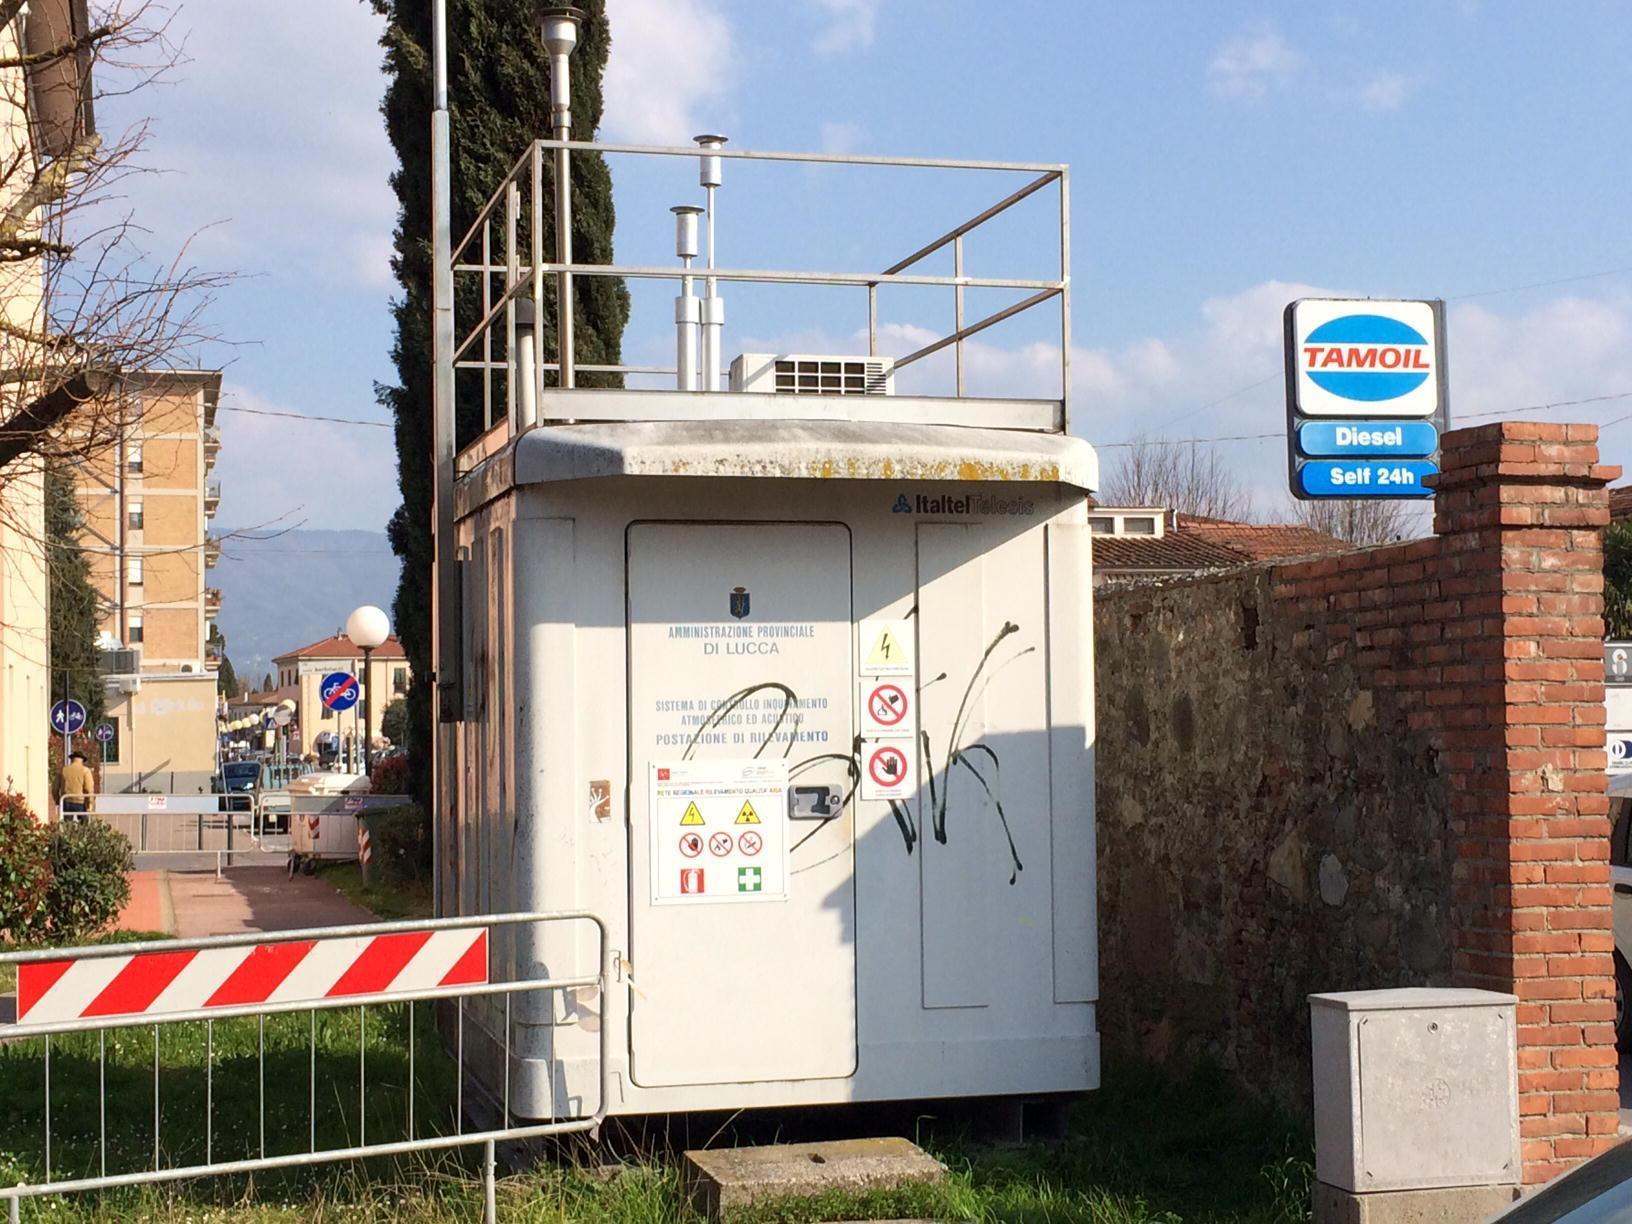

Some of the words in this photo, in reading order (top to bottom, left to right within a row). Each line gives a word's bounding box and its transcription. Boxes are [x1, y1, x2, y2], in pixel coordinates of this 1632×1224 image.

[1304, 347, 1430, 369] TAMOIL
[1335, 427, 1402, 446] Diesel
[1330, 467, 1371, 485] Self
[1377, 467, 1414, 485] 24h
[668, 626, 754, 639] AMMINISTRAZIONE
[757, 625, 815, 638] PROVINCIALE
[704, 643, 719, 655] DI
[726, 642, 780, 655] LUCCA
[655, 700, 694, 712] SISTEMA
[698, 700, 707, 711] DI
[763, 698, 828, 710] INQUNAMENTO
[746, 713, 758, 725] ED
[761, 712, 804, 725] ACUTICO
[733, 732, 745, 744] DI
